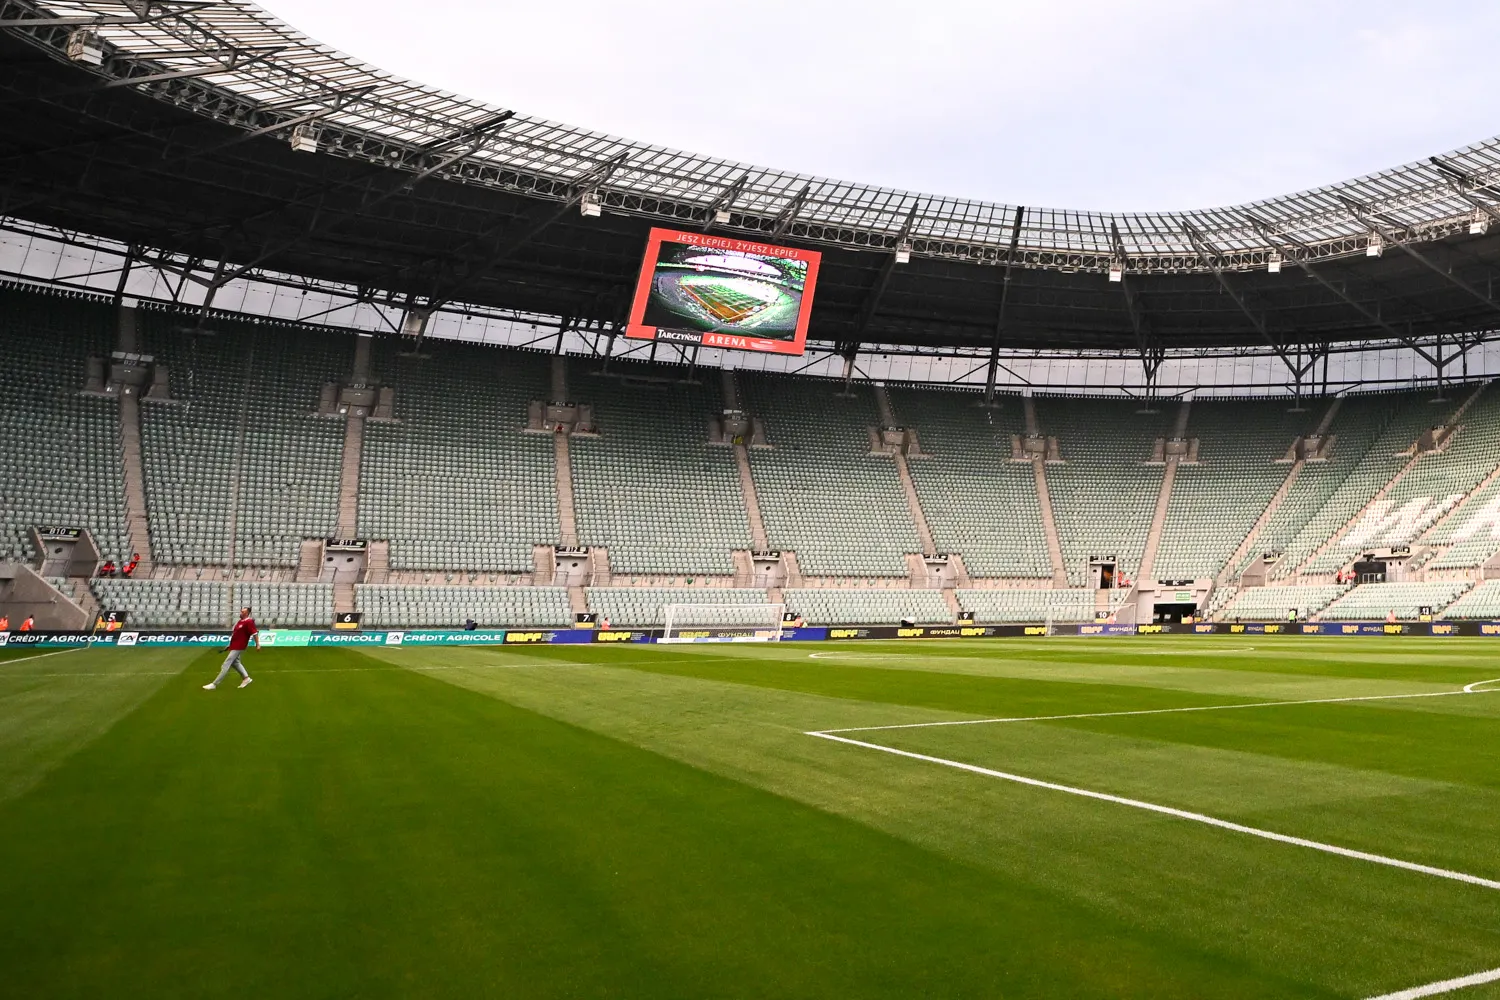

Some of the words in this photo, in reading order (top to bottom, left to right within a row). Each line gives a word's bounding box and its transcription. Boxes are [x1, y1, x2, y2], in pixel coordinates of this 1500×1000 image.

[677, 234, 698, 244] JESZ
[701, 237, 733, 249] LEPIEJ,
[736, 241, 767, 253] ŻYJESZ
[770, 248, 798, 258] LEPIEJ
[658, 329, 701, 342] TARCZYŃSKI
[708, 335, 746, 346] ARENA
[109, 613, 116, 622] 5
[344, 614, 351, 622] 6
[786, 613, 791, 621] 8
[963, 612, 968, 620] 9
[9, 634, 47, 643] CRÉDIT
[49, 635, 113, 643] AGRICOLE
[138, 634, 187, 643] CRÉDIT
[404, 634, 445, 642] CRÉDIT
